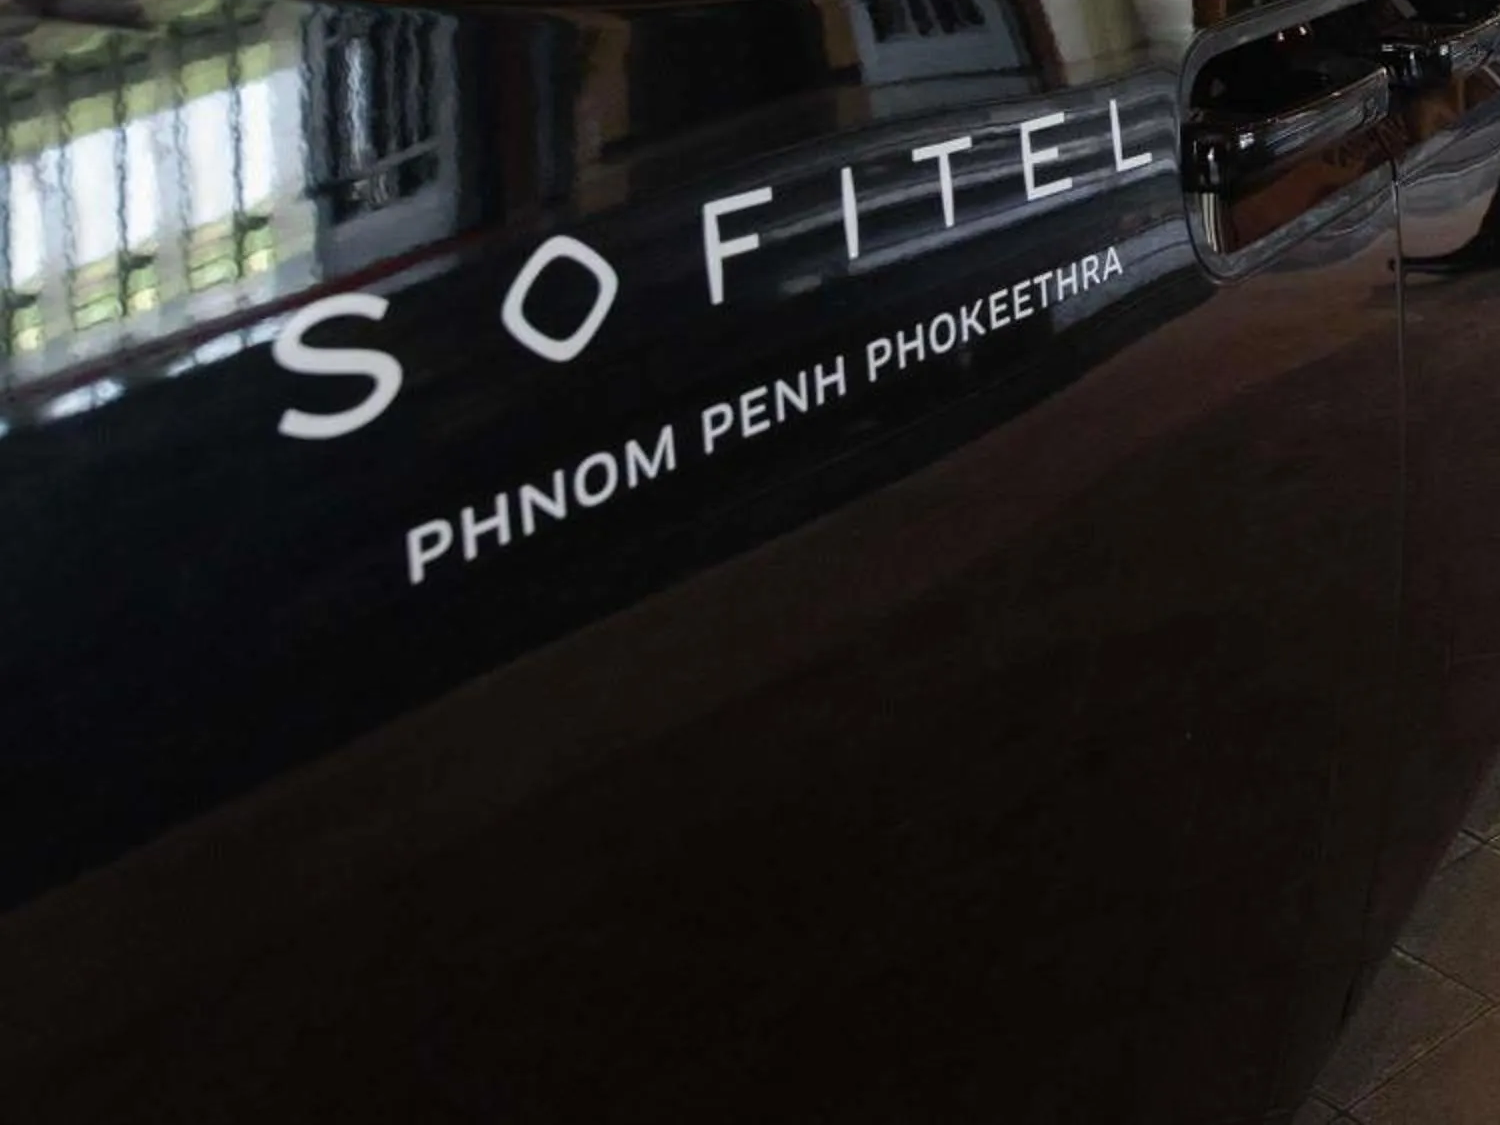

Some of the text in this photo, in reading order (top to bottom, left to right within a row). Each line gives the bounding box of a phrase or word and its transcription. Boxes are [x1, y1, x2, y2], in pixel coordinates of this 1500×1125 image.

[271, 98, 1154, 439] SOFITEL
[407, 245, 1124, 584] PHNOM PENH PHOKEETHRA
